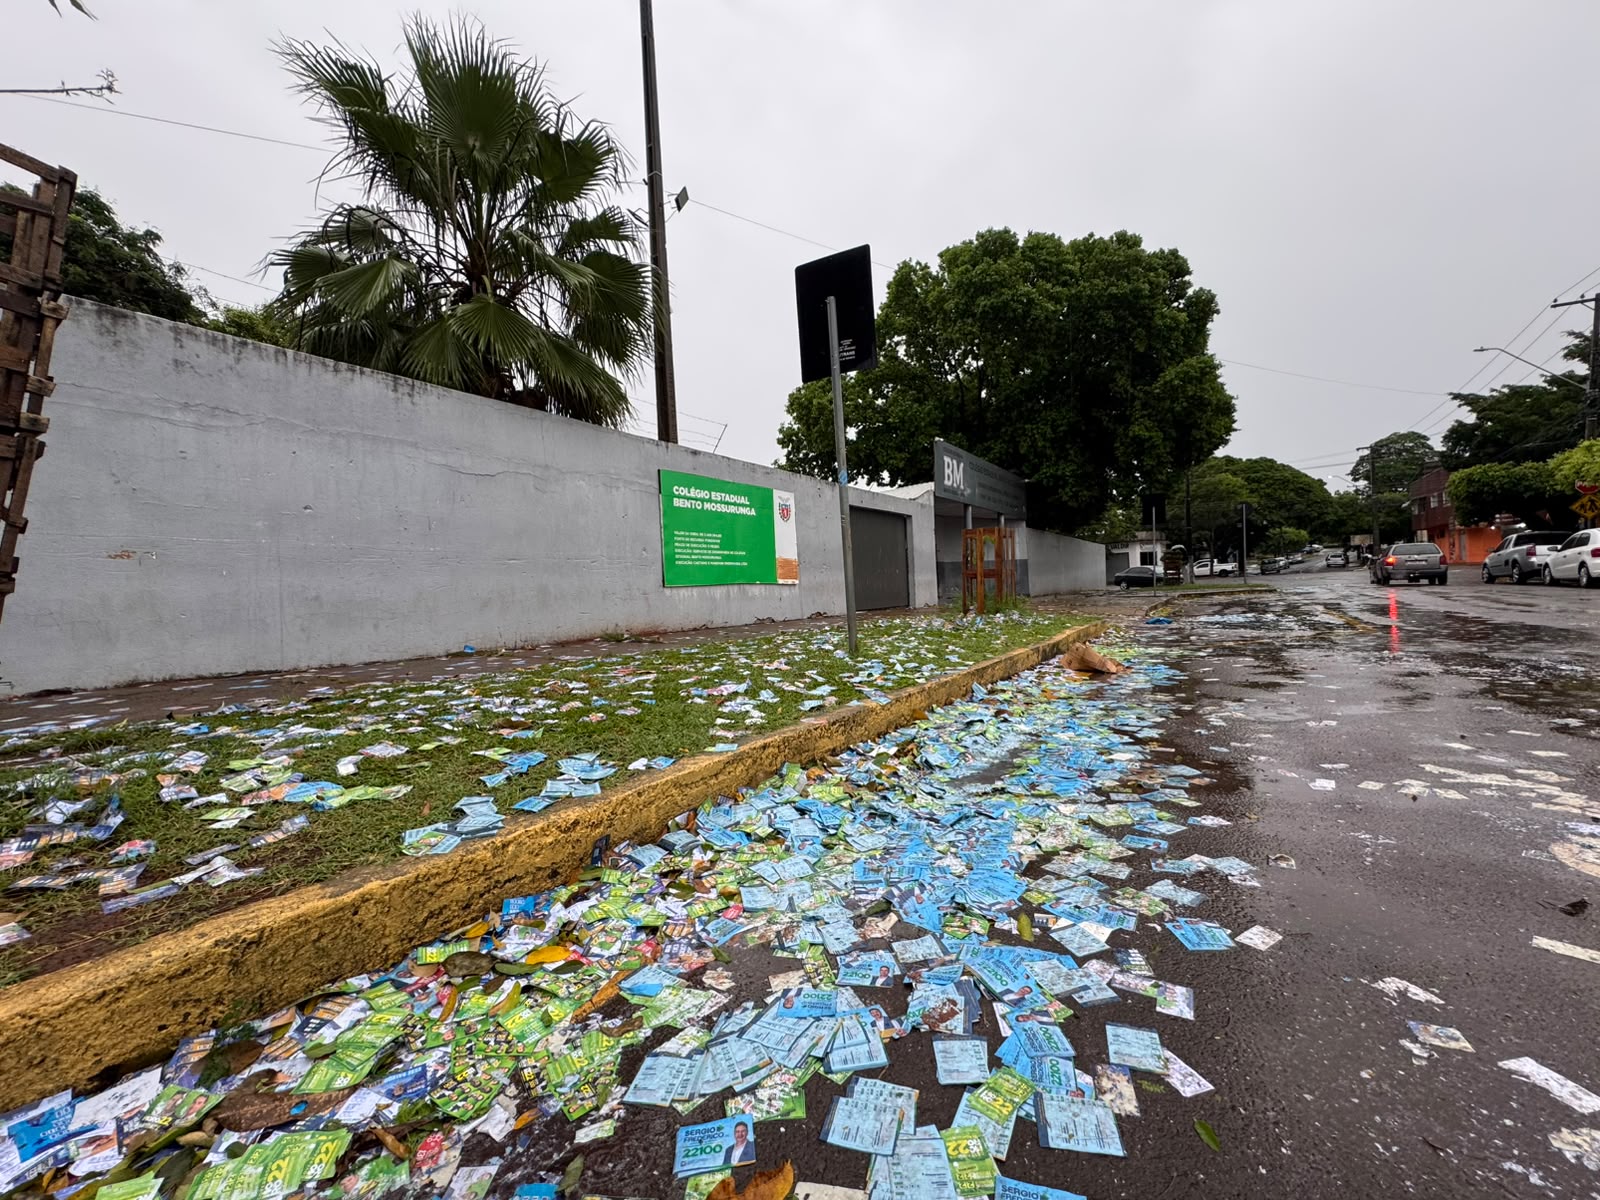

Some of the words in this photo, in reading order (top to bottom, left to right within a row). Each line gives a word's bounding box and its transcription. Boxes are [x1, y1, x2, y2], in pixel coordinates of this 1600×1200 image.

[943, 455, 964, 490] BM
[673, 485, 710, 499] COLÉGIO
[711, 491, 750, 505] ESTADUAL
[673, 497, 702, 510] BENTO
[703, 501, 756, 516] MOSSURUNGA
[1049, 1058, 1063, 1086] 22100
[991, 1097, 1013, 1115] 22
[683, 1132, 724, 1143] FREDERICO
[684, 1126, 716, 1137] SERGIO
[682, 1144, 723, 1158] 22100
[947, 1140, 970, 1156] 22
[1001, 1185, 1039, 1200] SERGIO
